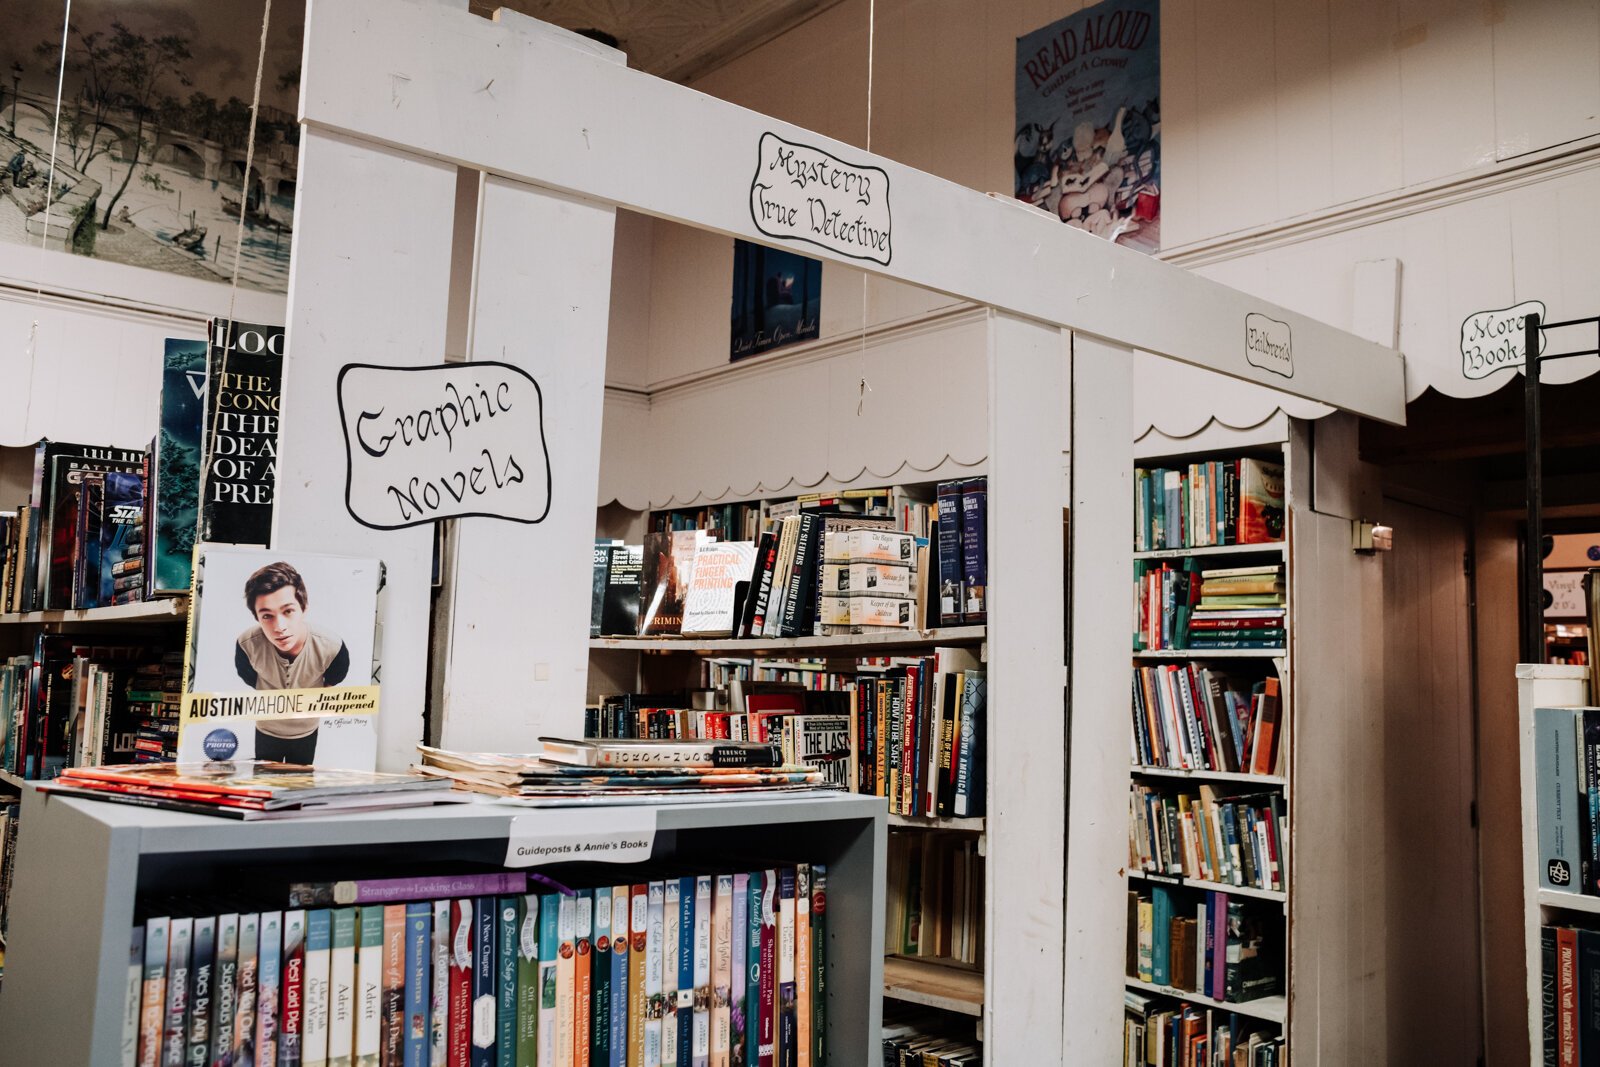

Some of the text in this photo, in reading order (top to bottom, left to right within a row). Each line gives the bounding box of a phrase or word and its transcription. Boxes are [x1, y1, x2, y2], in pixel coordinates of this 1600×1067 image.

[1024, 9, 1152, 90] READ ALOUD
[770, 146, 870, 206] Mystery
[755, 182, 889, 252] True Detective
[1470, 315, 1526, 343] More
[1248, 327, 1292, 363] Children's
[220, 372, 272, 392] THE
[356, 382, 513, 458] Graphic
[214, 460, 254, 479] OF
[387, 448, 524, 521] Novels
[795, 515, 812, 566] CITY SLEUTHS
[696, 566, 726, 578] FINGER
[698, 553, 742, 566] PRACTICAL
[694, 576, 734, 590] PRINTING
[754, 569, 773, 616] MAFIA
[785, 574, 801, 620] TOUGH GUYS
[190, 694, 304, 718] AUSTIN MAHONE
[308, 700, 375, 714] It Happened
[316, 691, 368, 703] Just How
[904, 674, 914, 746] AMERICAN POLICING
[891, 721, 899, 731] TO
[891, 732, 898, 742] BE
[804, 732, 848, 754] THE LAST
[890, 746, 898, 765] SAFE
[944, 742, 951, 750] OF
[958, 710, 970, 793] LOCKDOWN AMERICA
[516, 840, 648, 858] Guideposts & Annie's Books
[361, 880, 475, 898] Stranger Looking Glass
[483, 914, 490, 922] A
[750, 896, 761, 927] Deadly
[390, 932, 400, 967] Secrets
[438, 944, 448, 952] A
[504, 922, 515, 956] Beauty
[752, 929, 761, 948] Stitch
[482, 945, 490, 978] Chapter
[718, 937, 729, 972] Mystery
[242, 961, 255, 988] Noel
[502, 958, 514, 981] Shop
[309, 978, 317, 994] Out
[503, 982, 514, 1008] Tales
[1562, 992, 1573, 1008] North
[191, 964, 210, 1043] Woes By Any
[218, 963, 235, 1055] Suspicious Plots
[286, 958, 300, 1046] Best Laid Plants
[318, 980, 328, 1030] Like Fish
[338, 984, 350, 1021] Adrift
[366, 982, 377, 1020] Adrift
[390, 992, 400, 1026] Amish
[1542, 972, 1555, 1041] INDIANA
[168, 968, 187, 1064] Rooted Malice
[240, 1016, 253, 1042] Out
[308, 1008, 316, 1035] Water
[460, 981, 468, 1067] Unlocking Truth
[1562, 1009, 1574, 1040] America's
[386, 1027, 400, 1054] Diary
